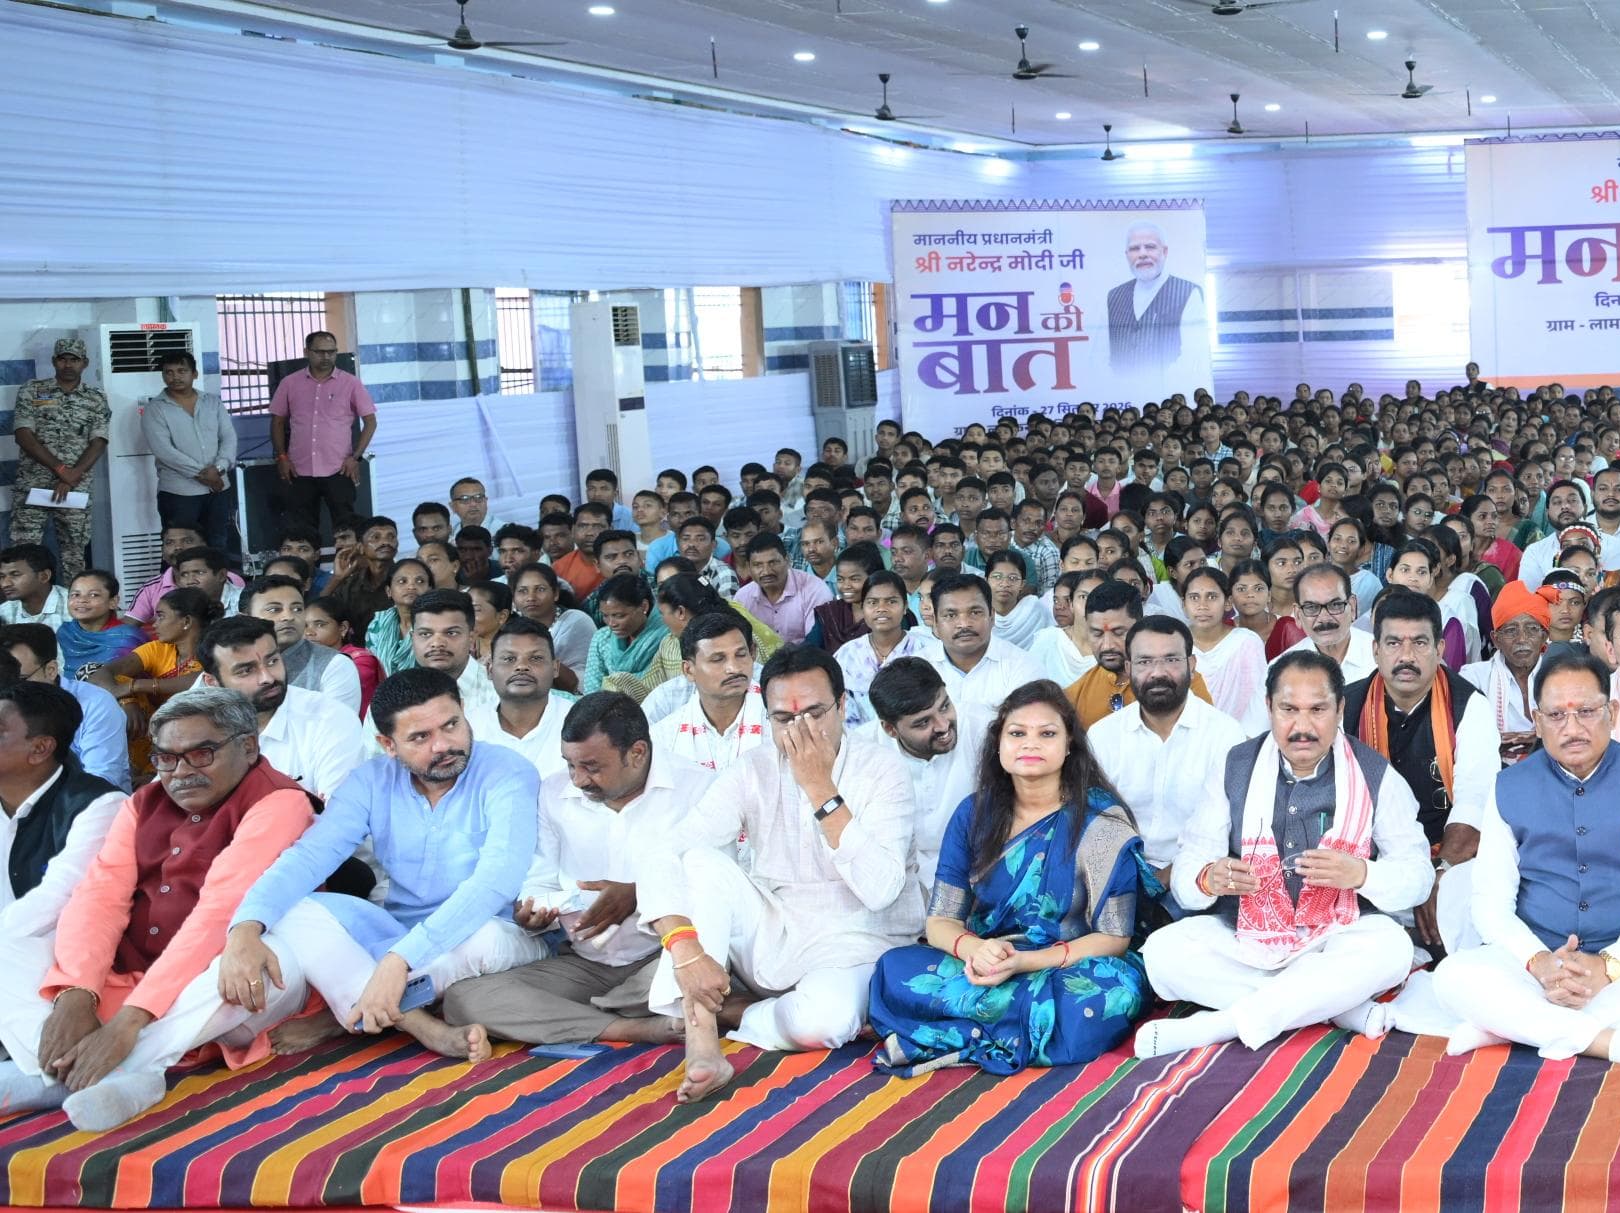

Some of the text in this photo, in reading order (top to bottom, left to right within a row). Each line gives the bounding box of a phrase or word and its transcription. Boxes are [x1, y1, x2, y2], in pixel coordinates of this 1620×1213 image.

[1591, 179, 1618, 203] श्री
[912, 228, 1053, 246] माननीय प्रधानमंत्री
[915, 248, 1085, 273] श्री नरेन्द्र मोदी जी
[910, 291, 1084, 337] मन की
[1546, 319, 1576, 333] ग्राम
[912, 335, 1089, 395] बात
[992, 405, 1030, 417] दिनांक
[1041, 406, 1055, 415] 27
